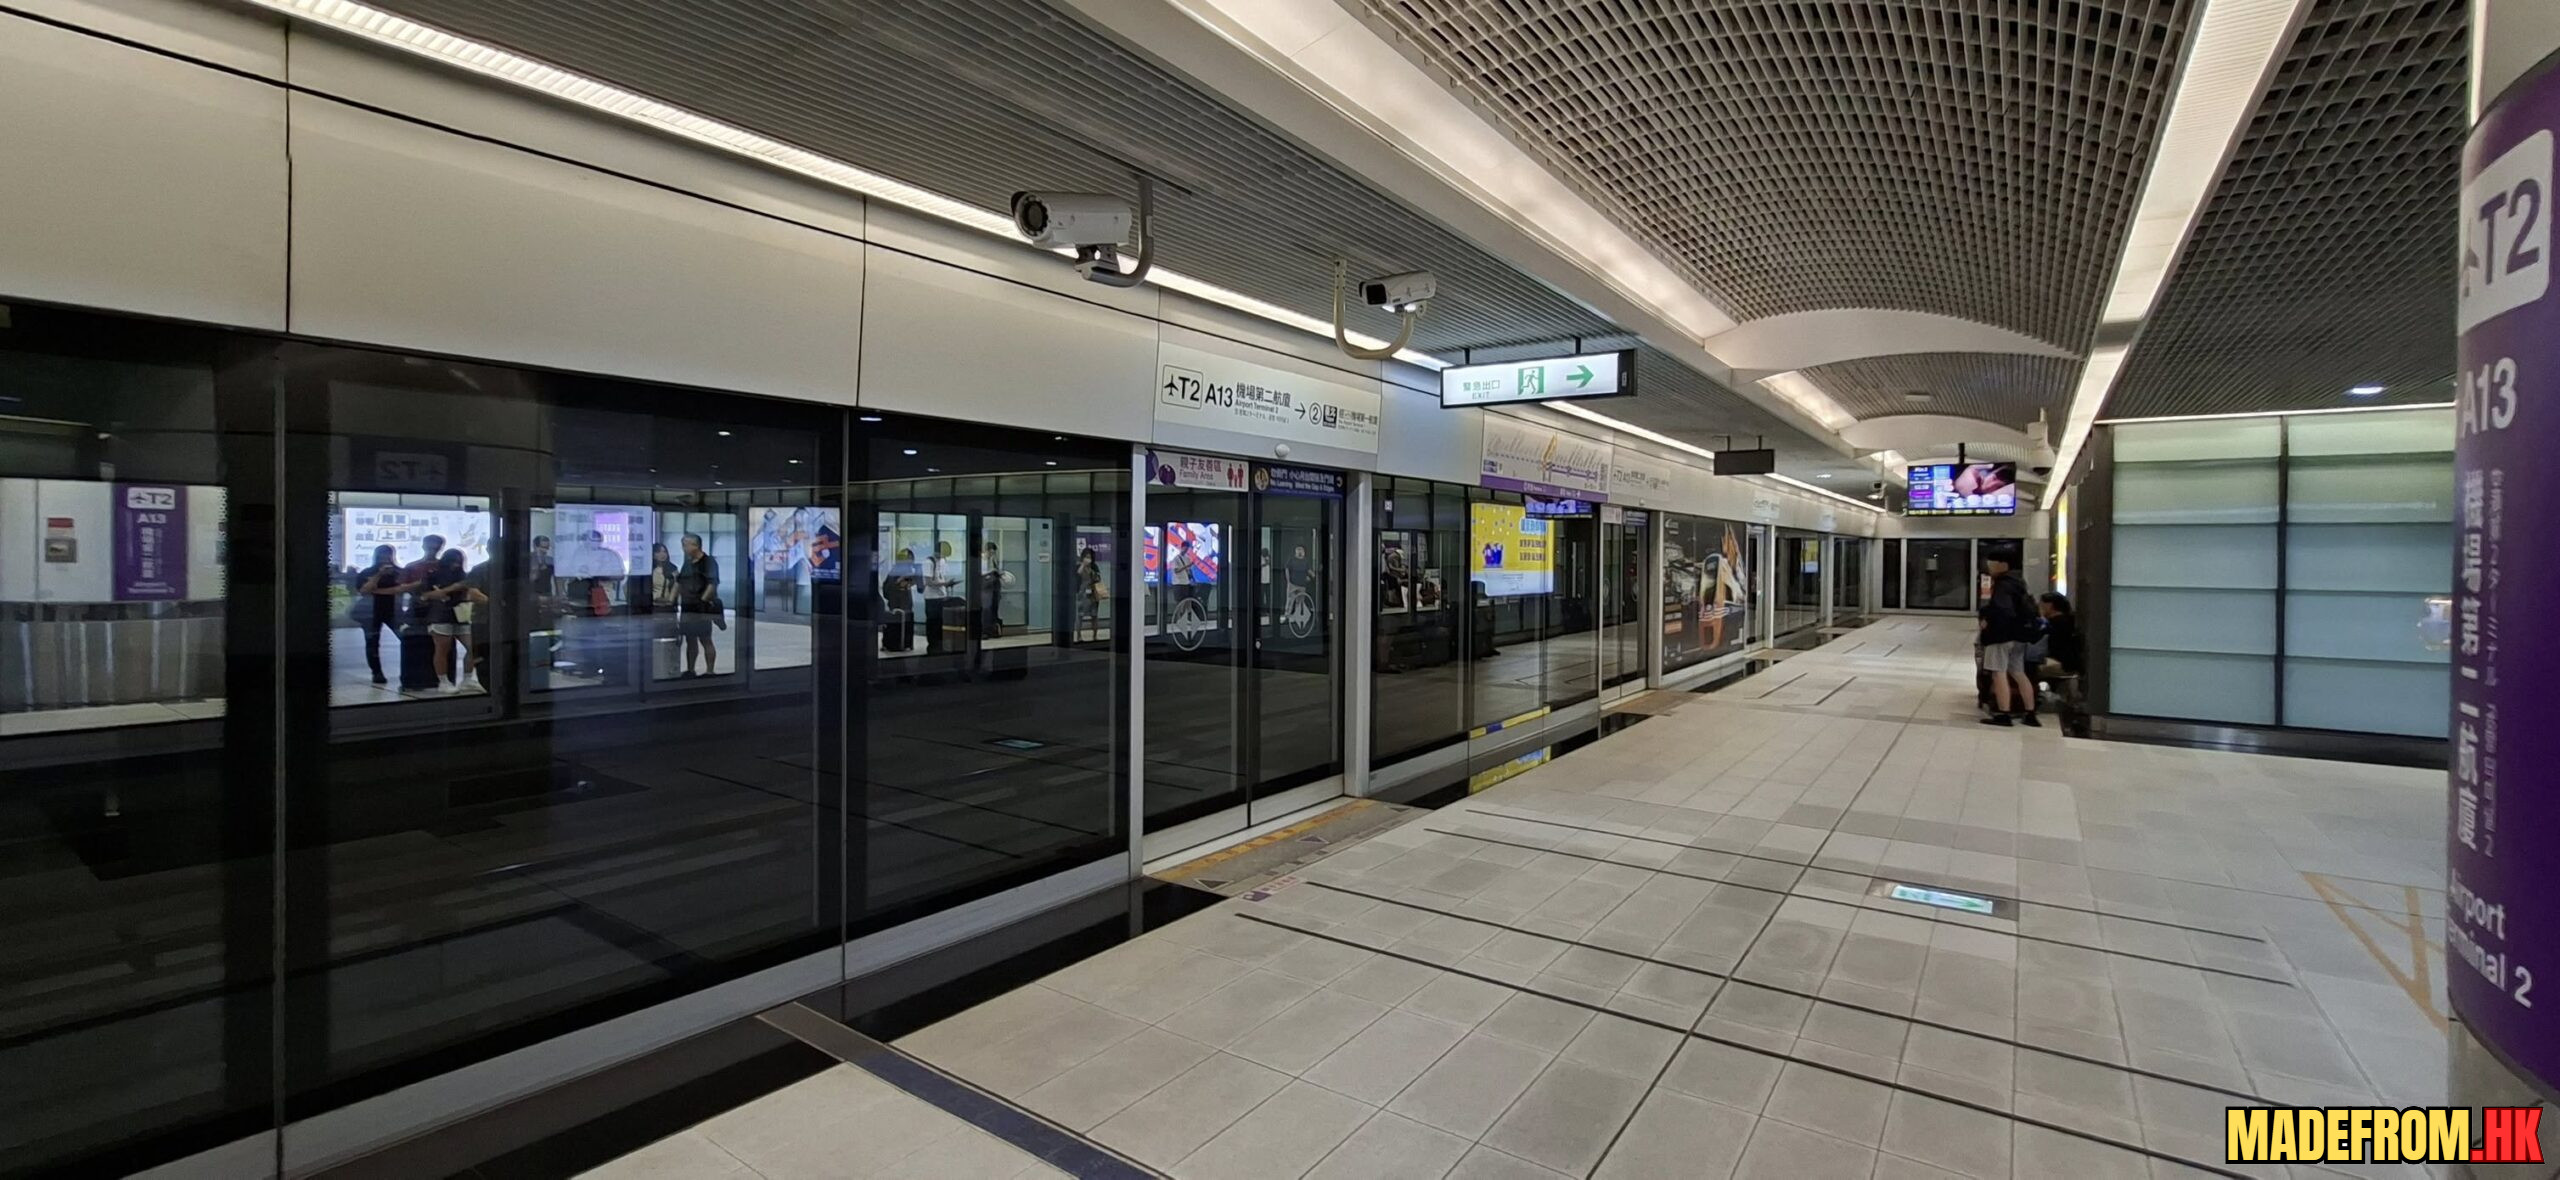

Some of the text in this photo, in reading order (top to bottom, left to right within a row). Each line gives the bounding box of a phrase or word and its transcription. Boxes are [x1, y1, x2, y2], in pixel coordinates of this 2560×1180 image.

[2478, 177, 2542, 286] T2
[1178, 376, 1233, 408] T2 A13
[1463, 380, 1500, 392] 緊急出口
[1235, 381, 1291, 408] 機場第二航廈
[1472, 391, 1490, 400] EXIT
[2459, 356, 2518, 439] A13
[1234, 399, 1253, 410] Airport
[1253, 401, 1275, 414] Terminal
[1179, 468, 1214, 481] Family Area
[146, 492, 173, 506] T2
[136, 512, 167, 524] A13
[2513, 965, 2533, 1009] 2
